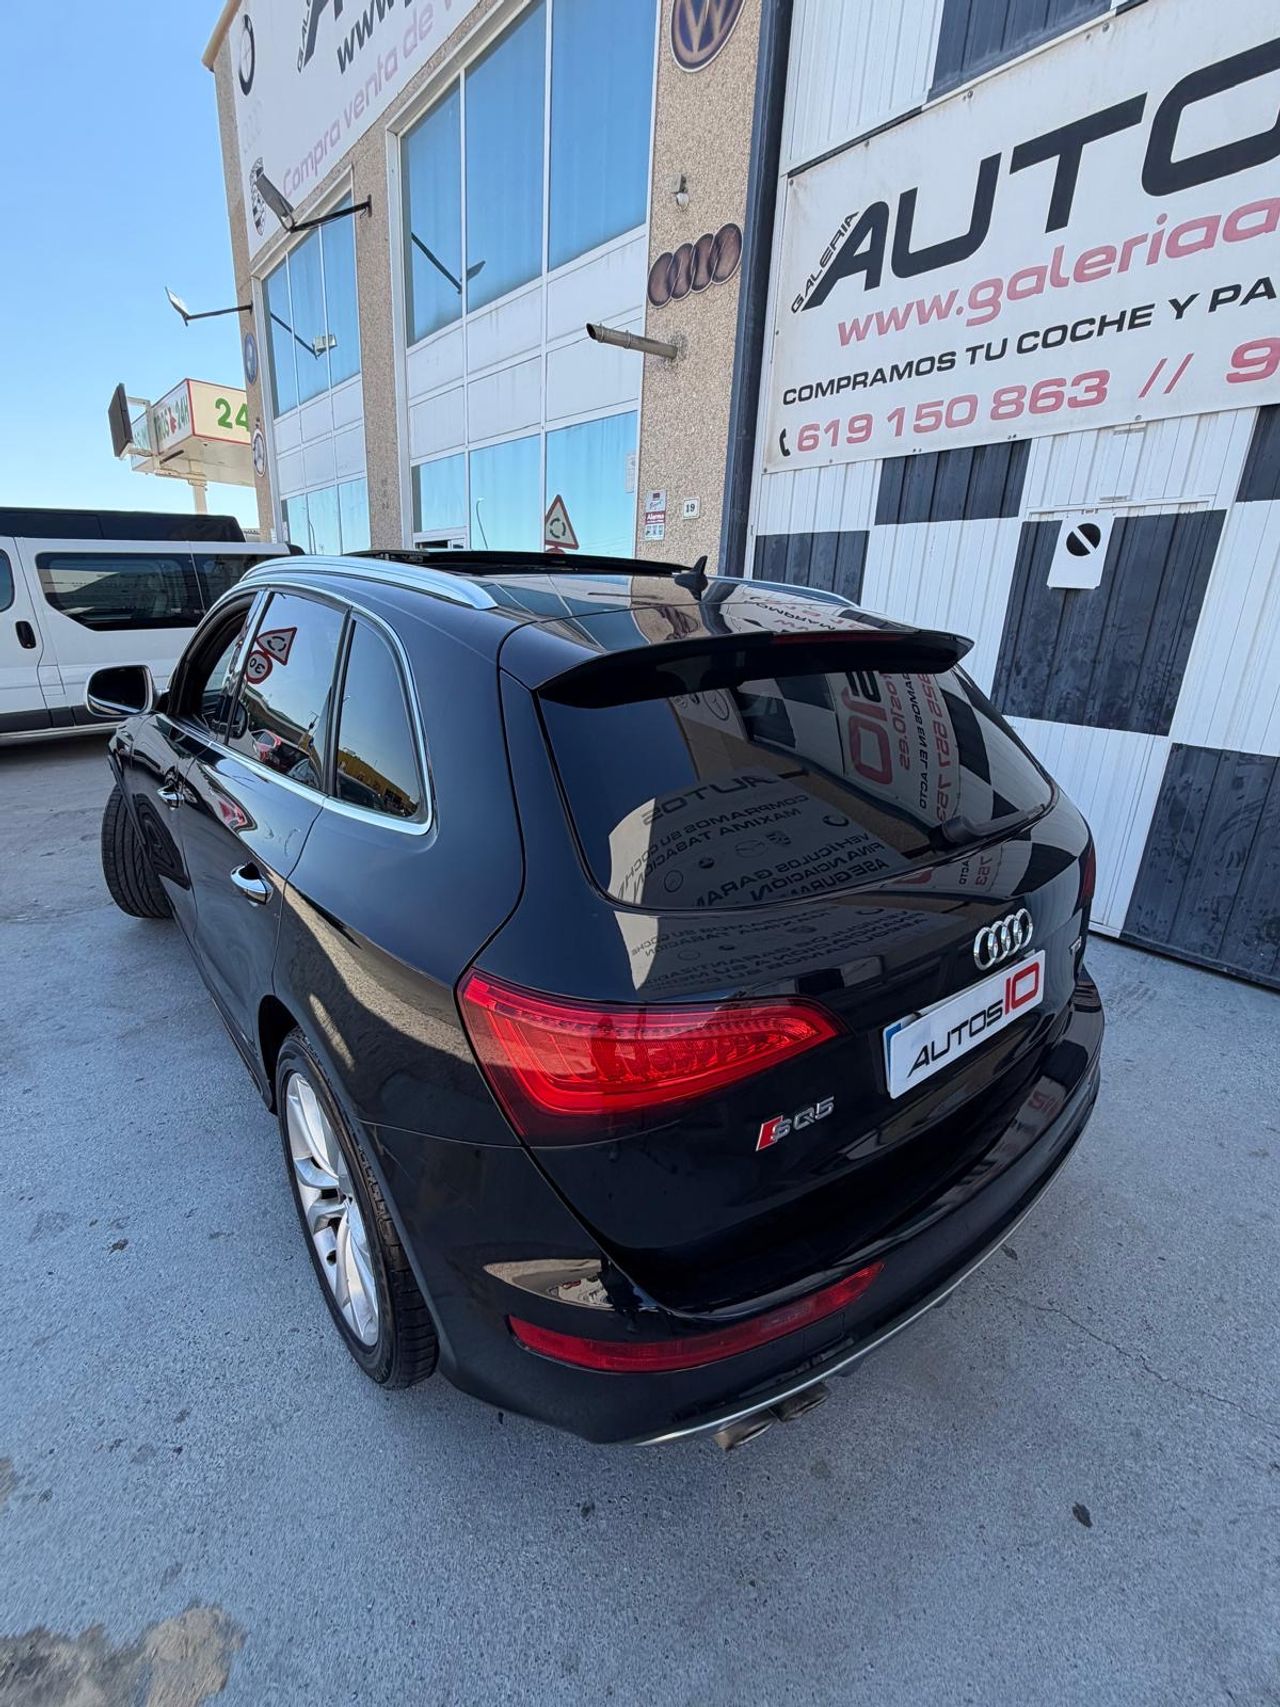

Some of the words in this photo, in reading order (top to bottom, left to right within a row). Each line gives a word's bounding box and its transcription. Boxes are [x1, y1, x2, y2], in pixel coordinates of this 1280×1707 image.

[283, 119, 341, 198] Compra
[344, 47, 399, 128] venta
[403, 3, 434, 59] de
[800, 37, 1280, 311] AUTO
[791, 211, 859, 314] GALERIA
[782, 351, 957, 406] COMPRAMOS
[965, 338, 1008, 365] TU
[1016, 303, 1156, 355] COCHE
[1168, 292, 1201, 320] Y
[1207, 276, 1278, 313] PA
[796, 413, 874, 452] 619
[887, 394, 979, 437] 150
[990, 369, 1110, 421] 863
[686, 503, 696, 513] 19
[907, 961, 1040, 1078] AUTOS10
[762, 1096, 835, 1147] SQ5
